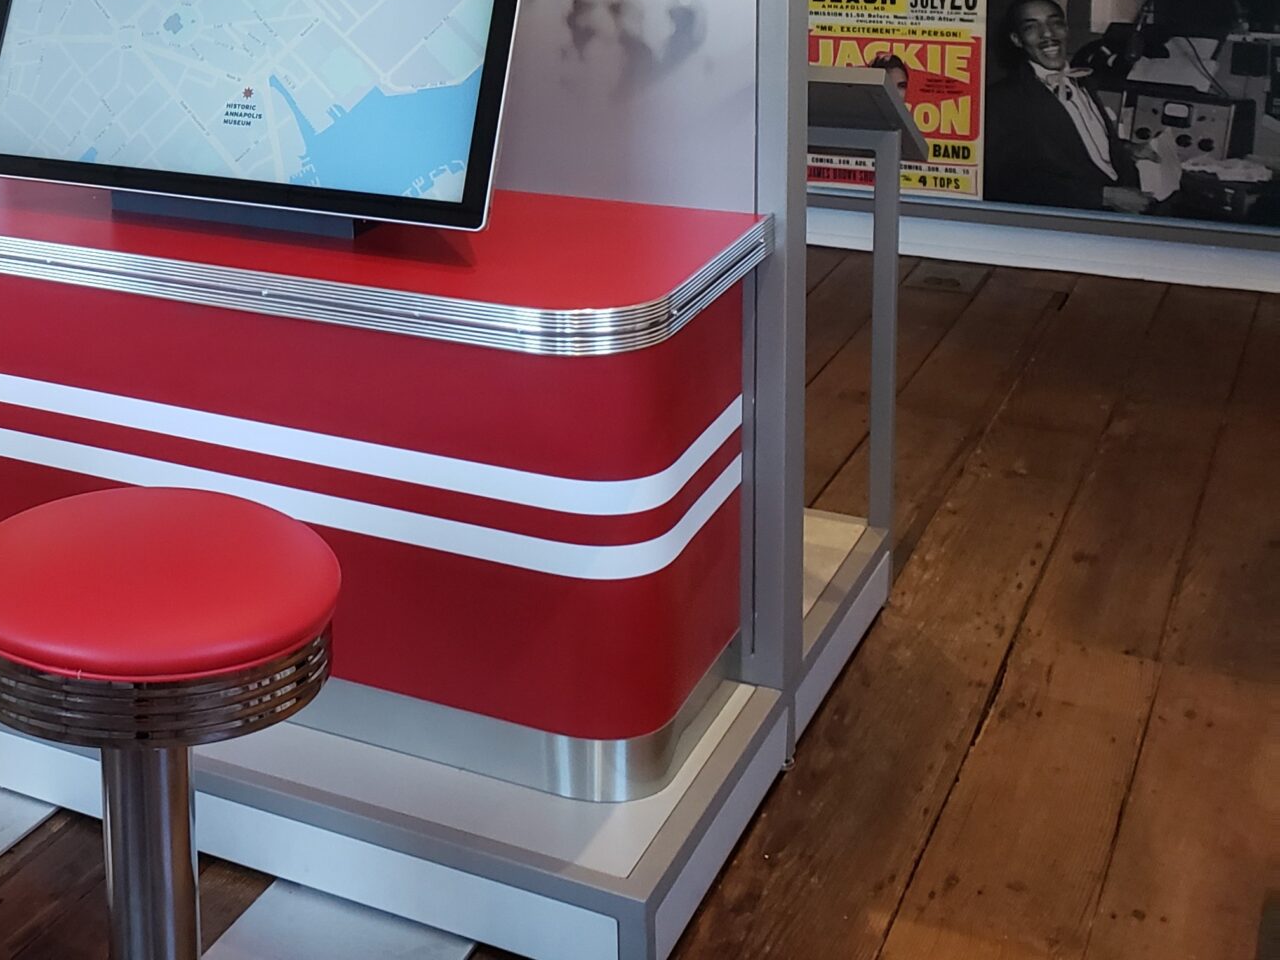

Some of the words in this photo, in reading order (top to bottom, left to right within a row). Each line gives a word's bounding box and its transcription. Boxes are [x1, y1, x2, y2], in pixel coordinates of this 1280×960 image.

[921, 30, 961, 38] PERSON!
[809, 39, 971, 83] JACKIE
[226, 102, 256, 111] HISTORIC
[224, 111, 262, 119] ANNAPOLIS
[932, 144, 971, 160] BAND
[918, 176, 927, 187] 4
[933, 177, 960, 189] TOPS
